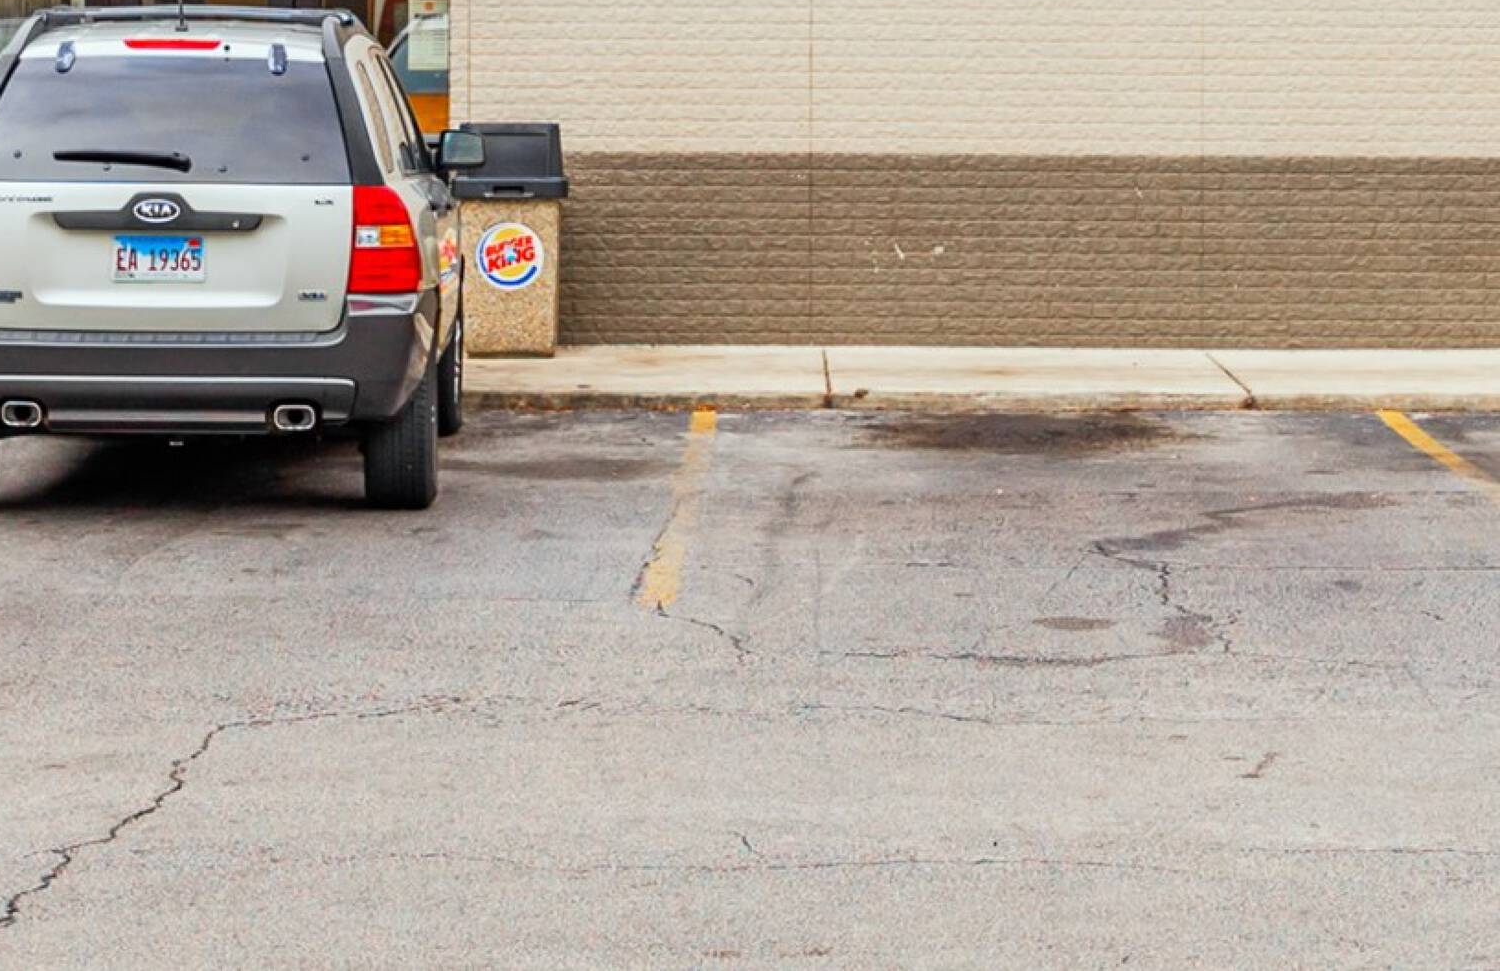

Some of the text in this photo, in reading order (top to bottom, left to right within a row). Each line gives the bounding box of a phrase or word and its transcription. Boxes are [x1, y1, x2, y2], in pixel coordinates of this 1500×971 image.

[140, 202, 172, 217] KIA
[116, 246, 201, 271] EA 19365
